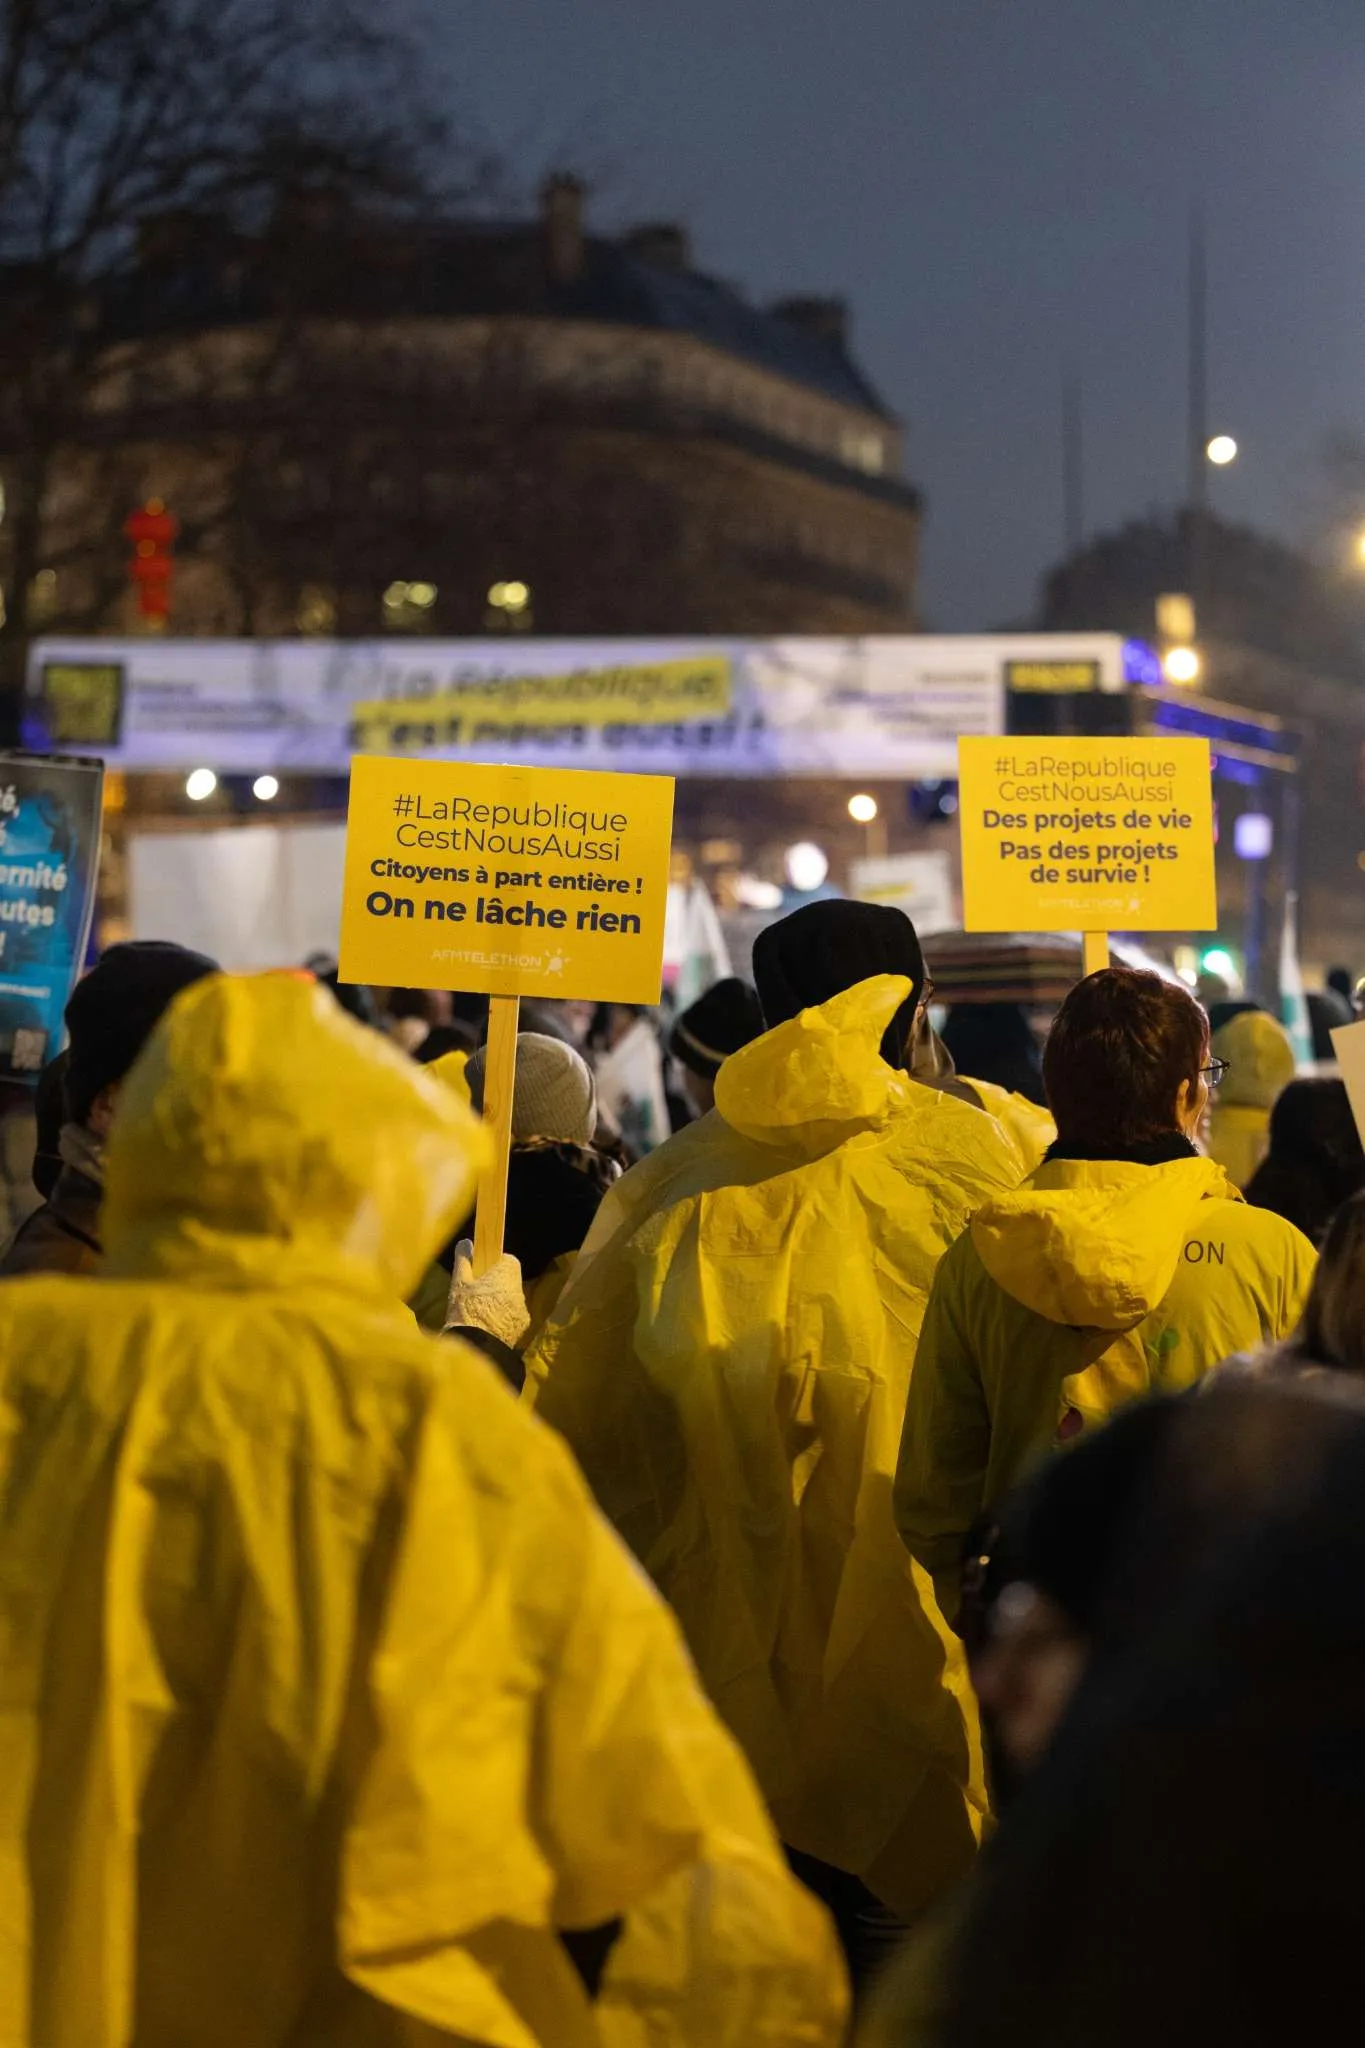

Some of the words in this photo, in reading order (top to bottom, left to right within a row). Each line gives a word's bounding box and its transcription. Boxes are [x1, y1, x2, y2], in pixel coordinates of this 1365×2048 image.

[995, 757, 1177, 781] #LaRepublique
[999, 781, 1172, 802] CestNousAussi
[393, 793, 628, 837] #LaRepublique
[981, 809, 1028, 830] Des
[1033, 808, 1117, 833] projets
[1122, 809, 1152, 829] de
[1157, 808, 1193, 829] vie
[397, 823, 621, 863] CestNousAussi
[1000, 841, 1042, 860] Pas
[1048, 840, 1090, 860] des
[1096, 839, 1179, 864] projets
[370, 858, 470, 885] Citoyens
[475, 865, 489, 885] à
[495, 870, 543, 890] part
[548, 872, 631, 894] entière
[1029, 864, 1060, 884] de
[1066, 863, 1138, 884] survie
[366, 891, 414, 920] On
[424, 899, 467, 922] ne
[476, 897, 568, 928] lâche
[576, 903, 641, 934] rien
[1178, 1240, 1225, 1265] ON
